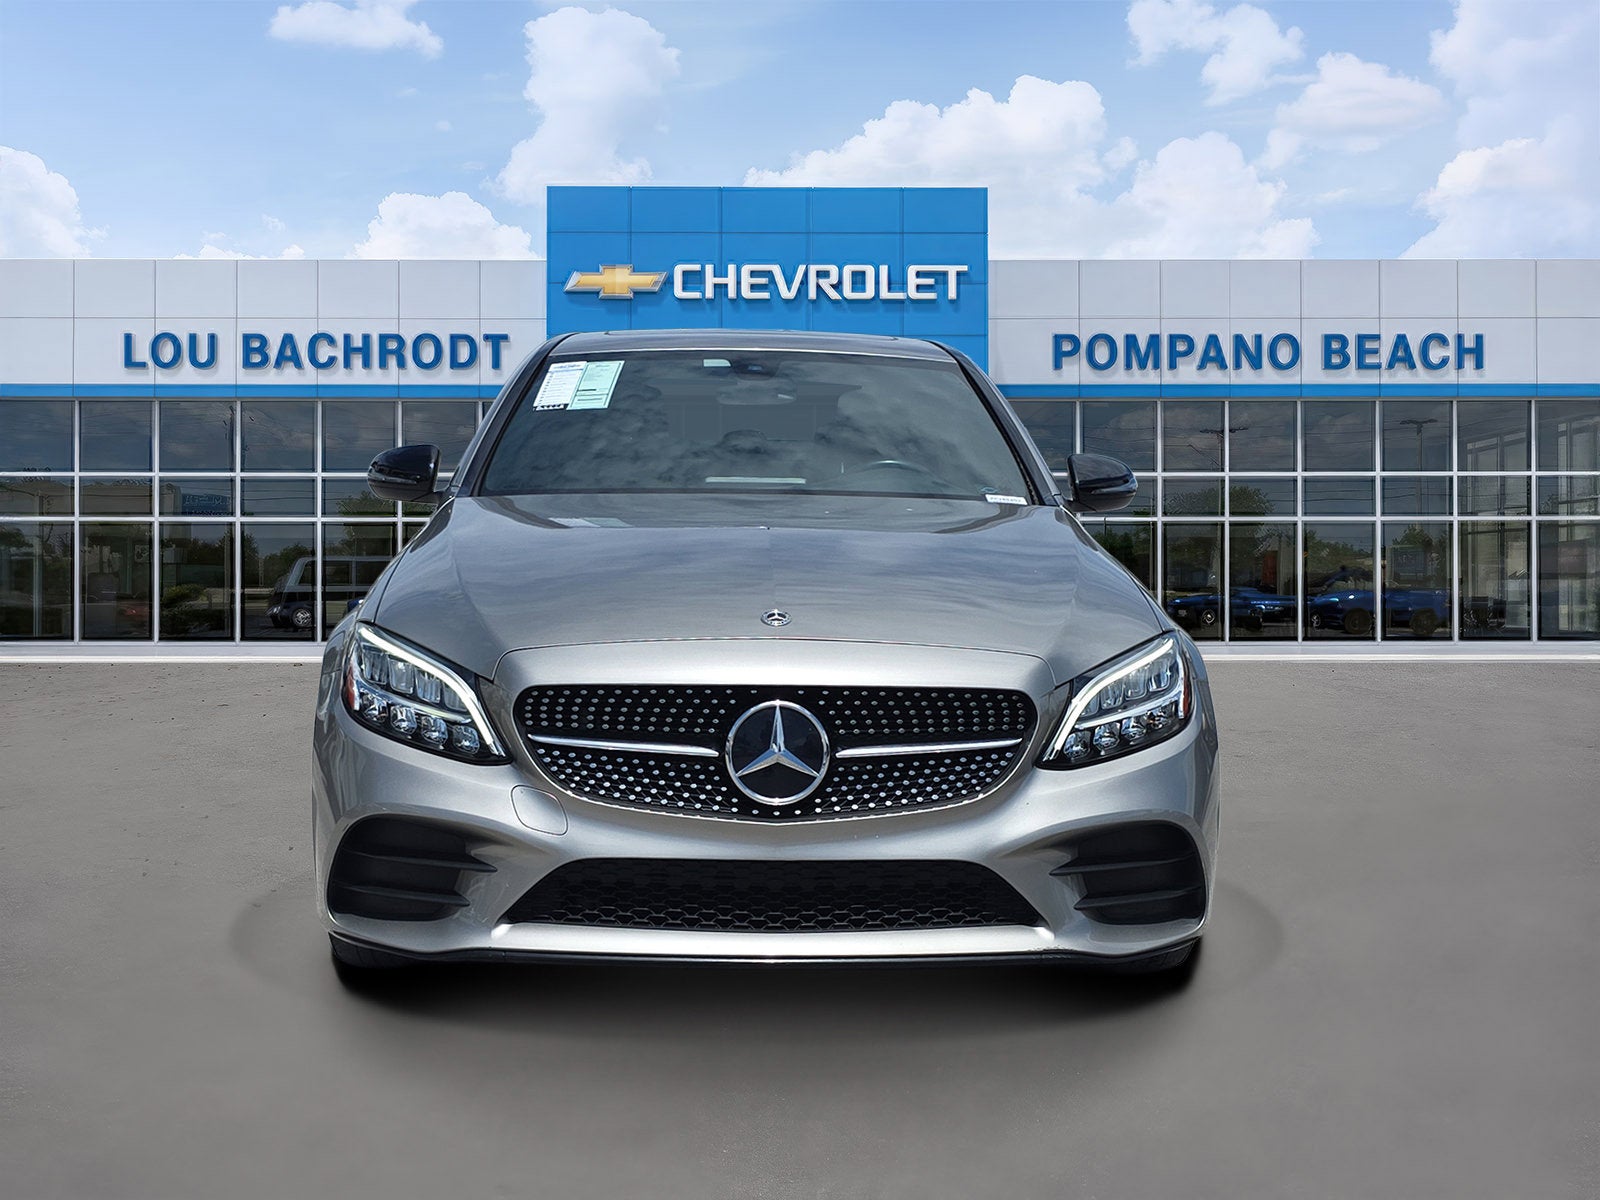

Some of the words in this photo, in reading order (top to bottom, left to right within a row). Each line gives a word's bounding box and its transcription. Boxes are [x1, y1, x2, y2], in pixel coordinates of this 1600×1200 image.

[673, 264, 969, 301] CHEVROLET
[123, 332, 219, 371] LOU
[241, 332, 510, 371] BACHRODT
[1052, 332, 1301, 371] POMPANO
[1321, 332, 1485, 371] BEACH
